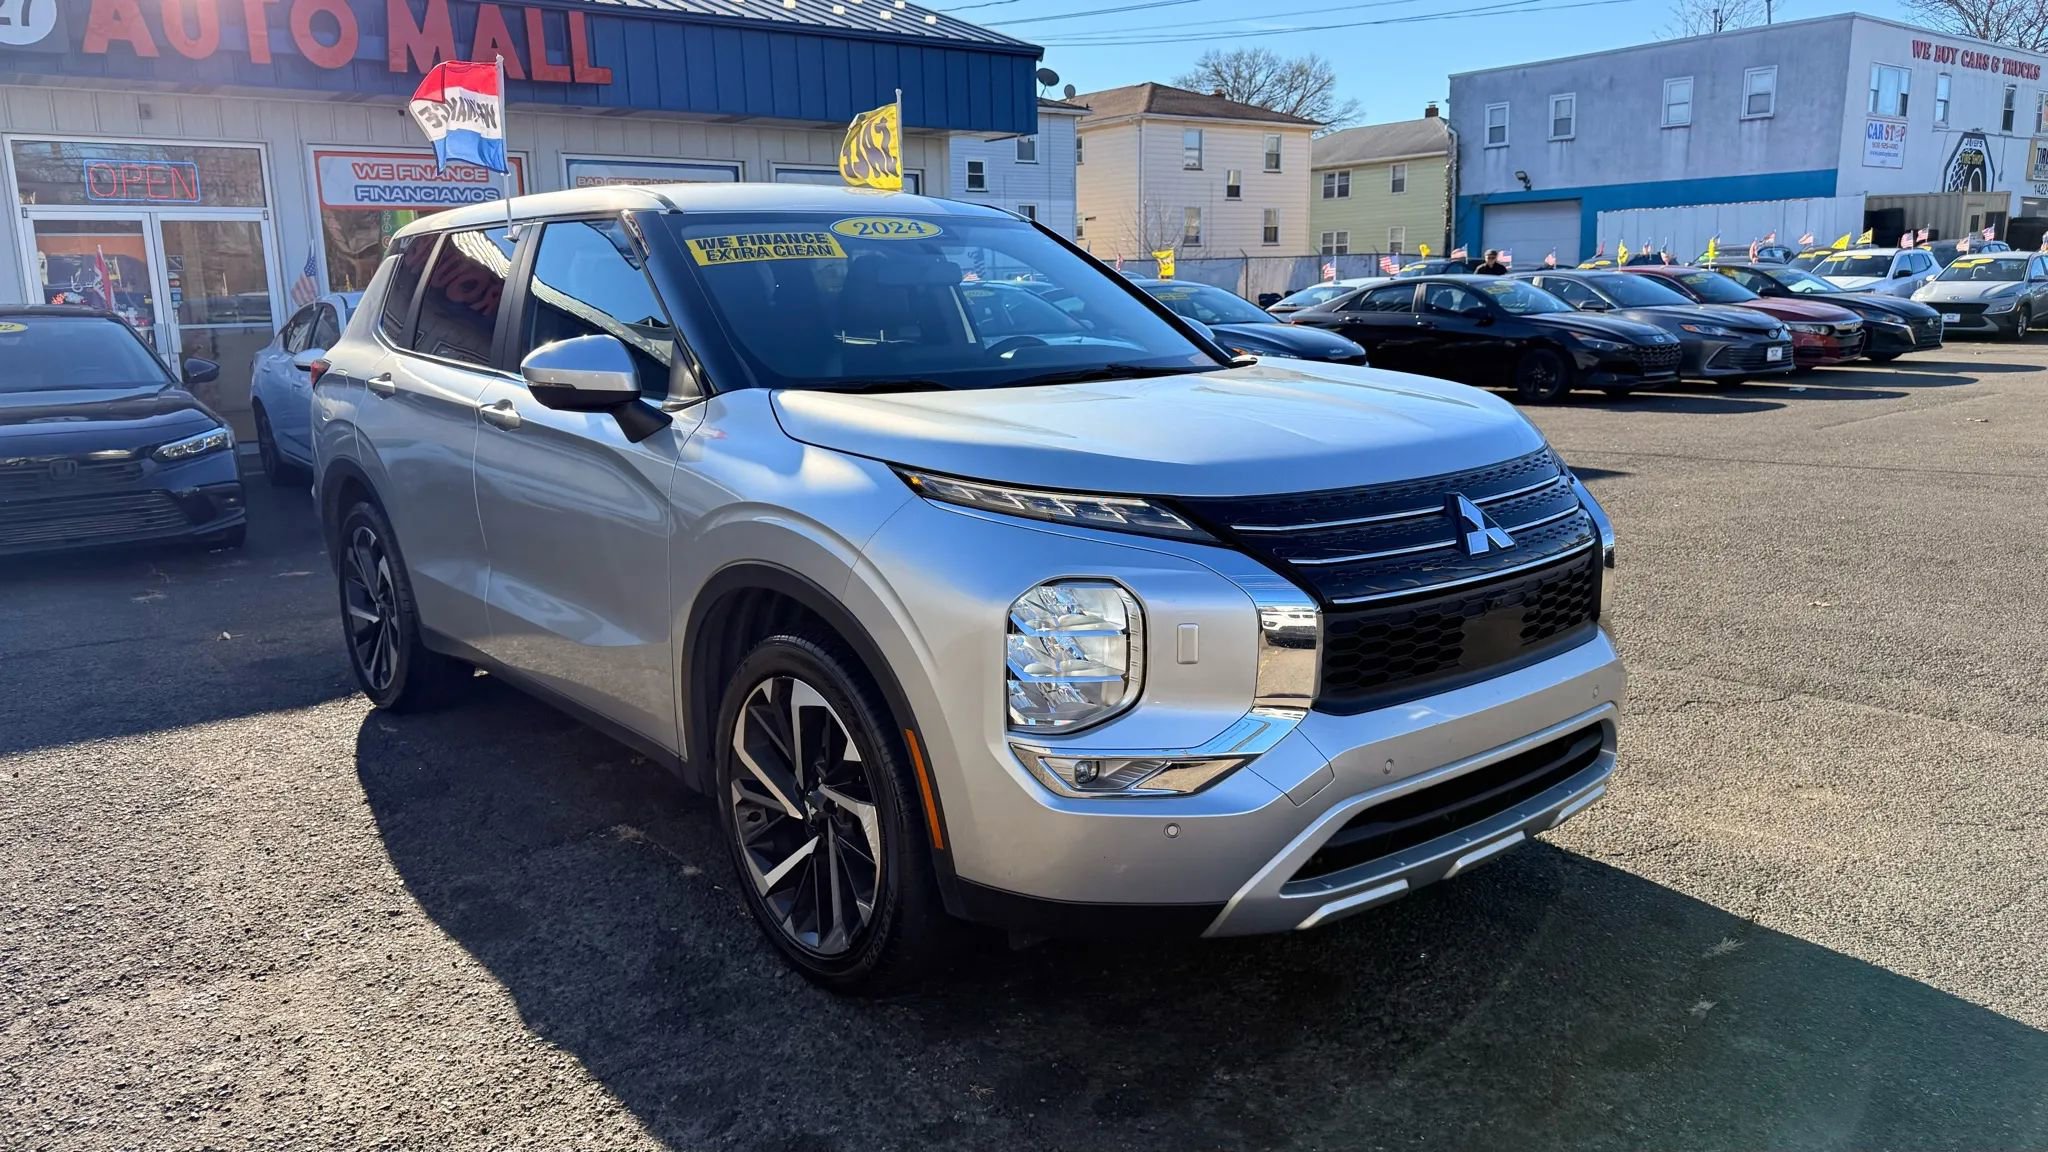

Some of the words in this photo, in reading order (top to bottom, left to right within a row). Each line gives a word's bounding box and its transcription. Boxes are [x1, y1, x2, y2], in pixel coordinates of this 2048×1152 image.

[82, 0, 359, 69] AUTO
[386, 0, 613, 85] MALL
[1912, 40, 1932, 60] WE
[1934, 45, 1960, 65] BUY
[1961, 50, 1990, 71] CARS
[2002, 58, 2041, 80] TRUCKS
[1868, 122, 1884, 140] CAR
[89, 163, 196, 199] OPEN
[353, 163, 393, 180] WE
[397, 165, 489, 183] FINANCE
[576, 176, 605, 187] BAD
[354, 185, 500, 202] FINANCIAMOS
[853, 221, 926, 236] 2024
[695, 238, 733, 250] WE
[736, 233, 829, 247] FINANCE
[706, 246, 770, 262] EXTRA
[772, 244, 833, 257] CLEAN
